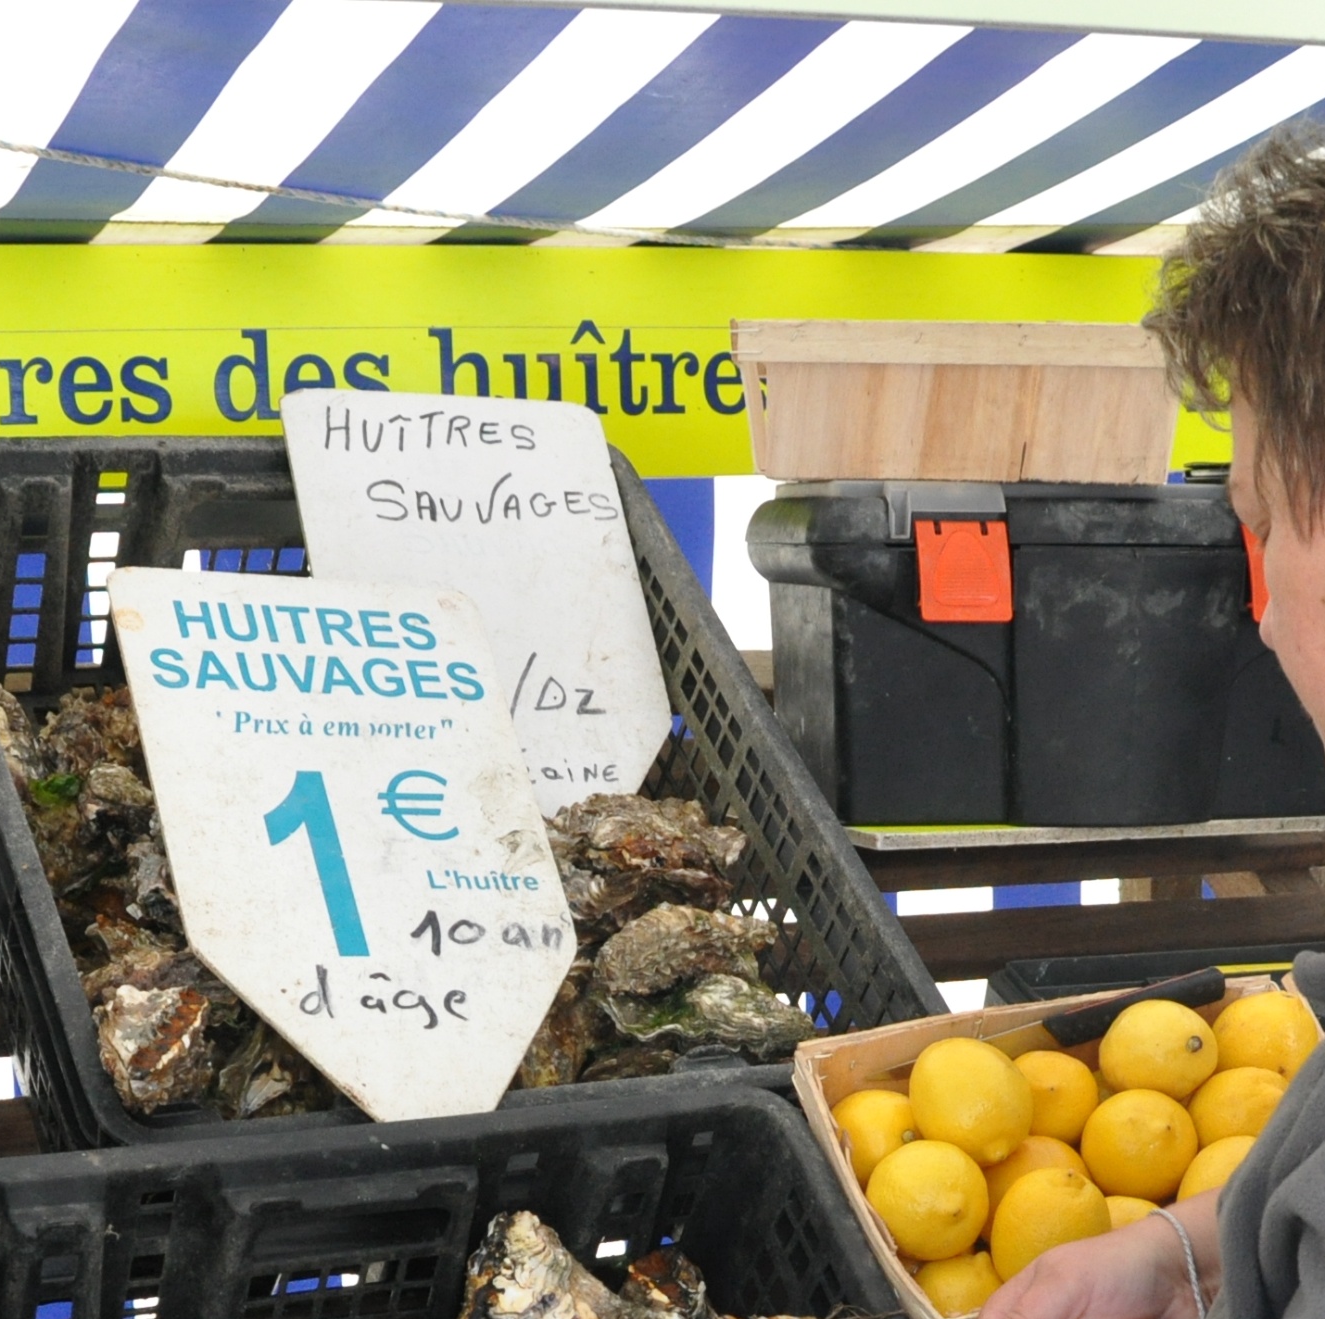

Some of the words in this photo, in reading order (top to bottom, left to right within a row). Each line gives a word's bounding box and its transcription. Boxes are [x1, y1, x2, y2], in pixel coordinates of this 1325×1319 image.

[214, 328, 391, 422] des
[428, 320, 766, 414] huître
[366, 472, 620, 525] SAUVAGES
[172, 599, 437, 652] HUITRES
[148, 648, 486, 702] SAUVAGES
[298, 712, 313, 736] à
[263, 770, 370, 957] 1
[377, 769, 460, 841] €
[426, 869, 540, 892] L'huître
[410, 909, 486, 957] 10
